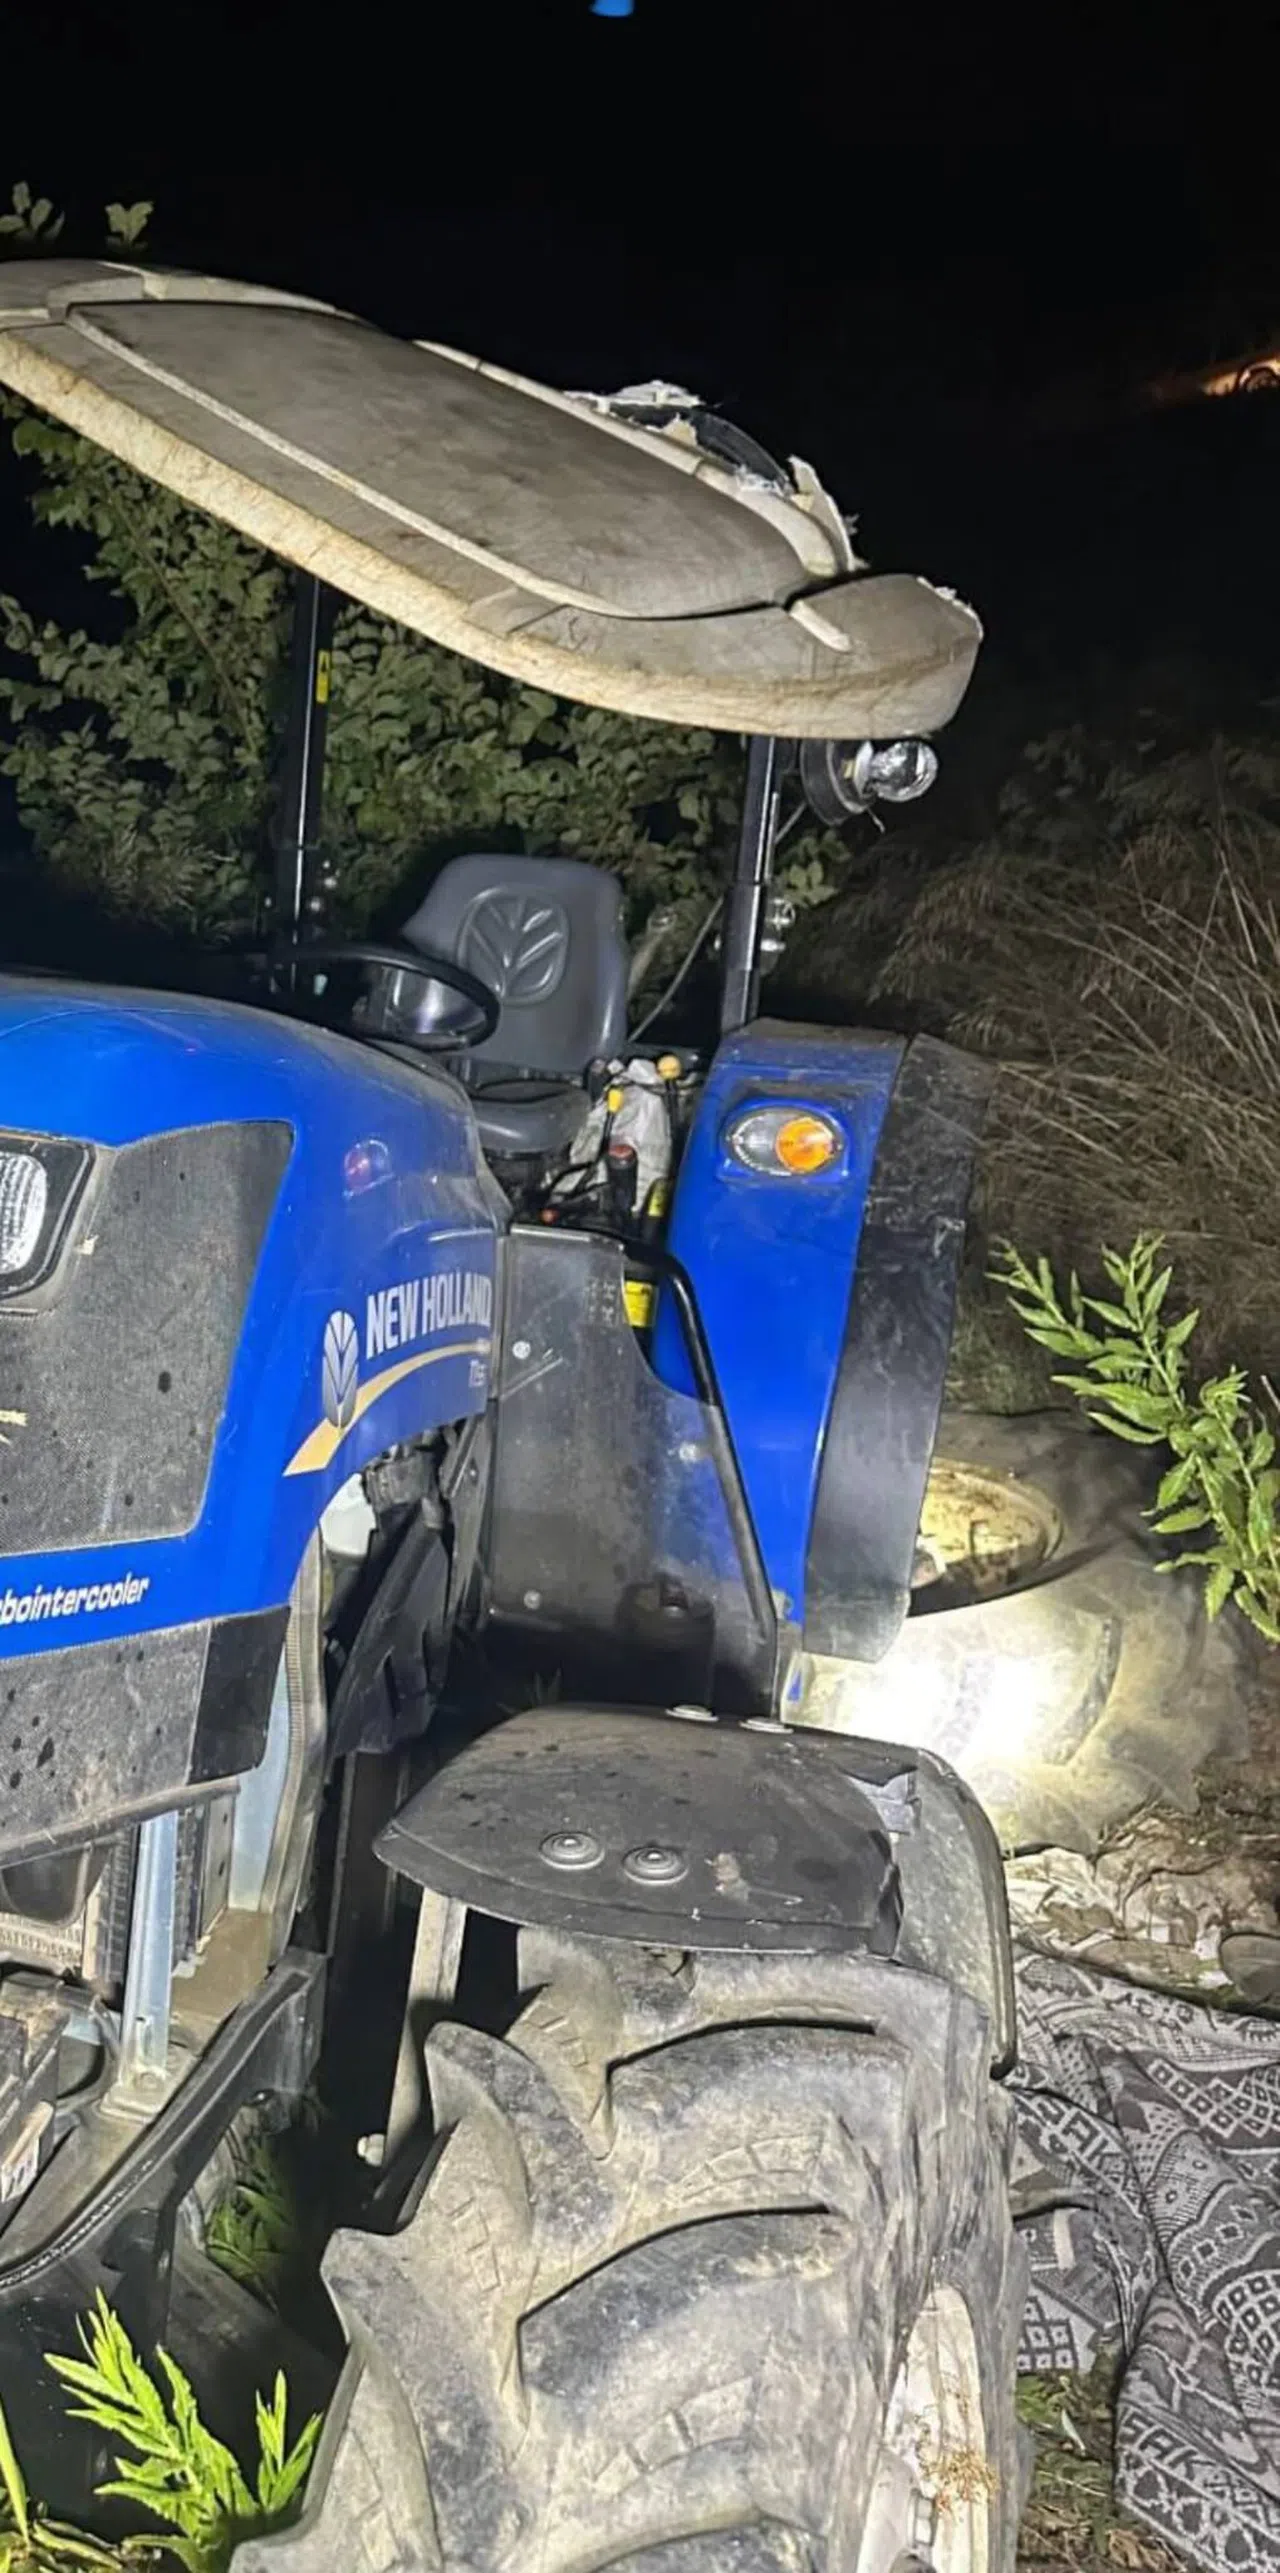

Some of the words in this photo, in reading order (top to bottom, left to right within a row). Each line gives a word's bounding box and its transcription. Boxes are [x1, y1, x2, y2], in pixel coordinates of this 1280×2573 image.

[366, 1279, 420, 1359] NEW
[422, 1270, 492, 1335] HOLLAND
[0, 1571, 149, 1625] bointercooler
